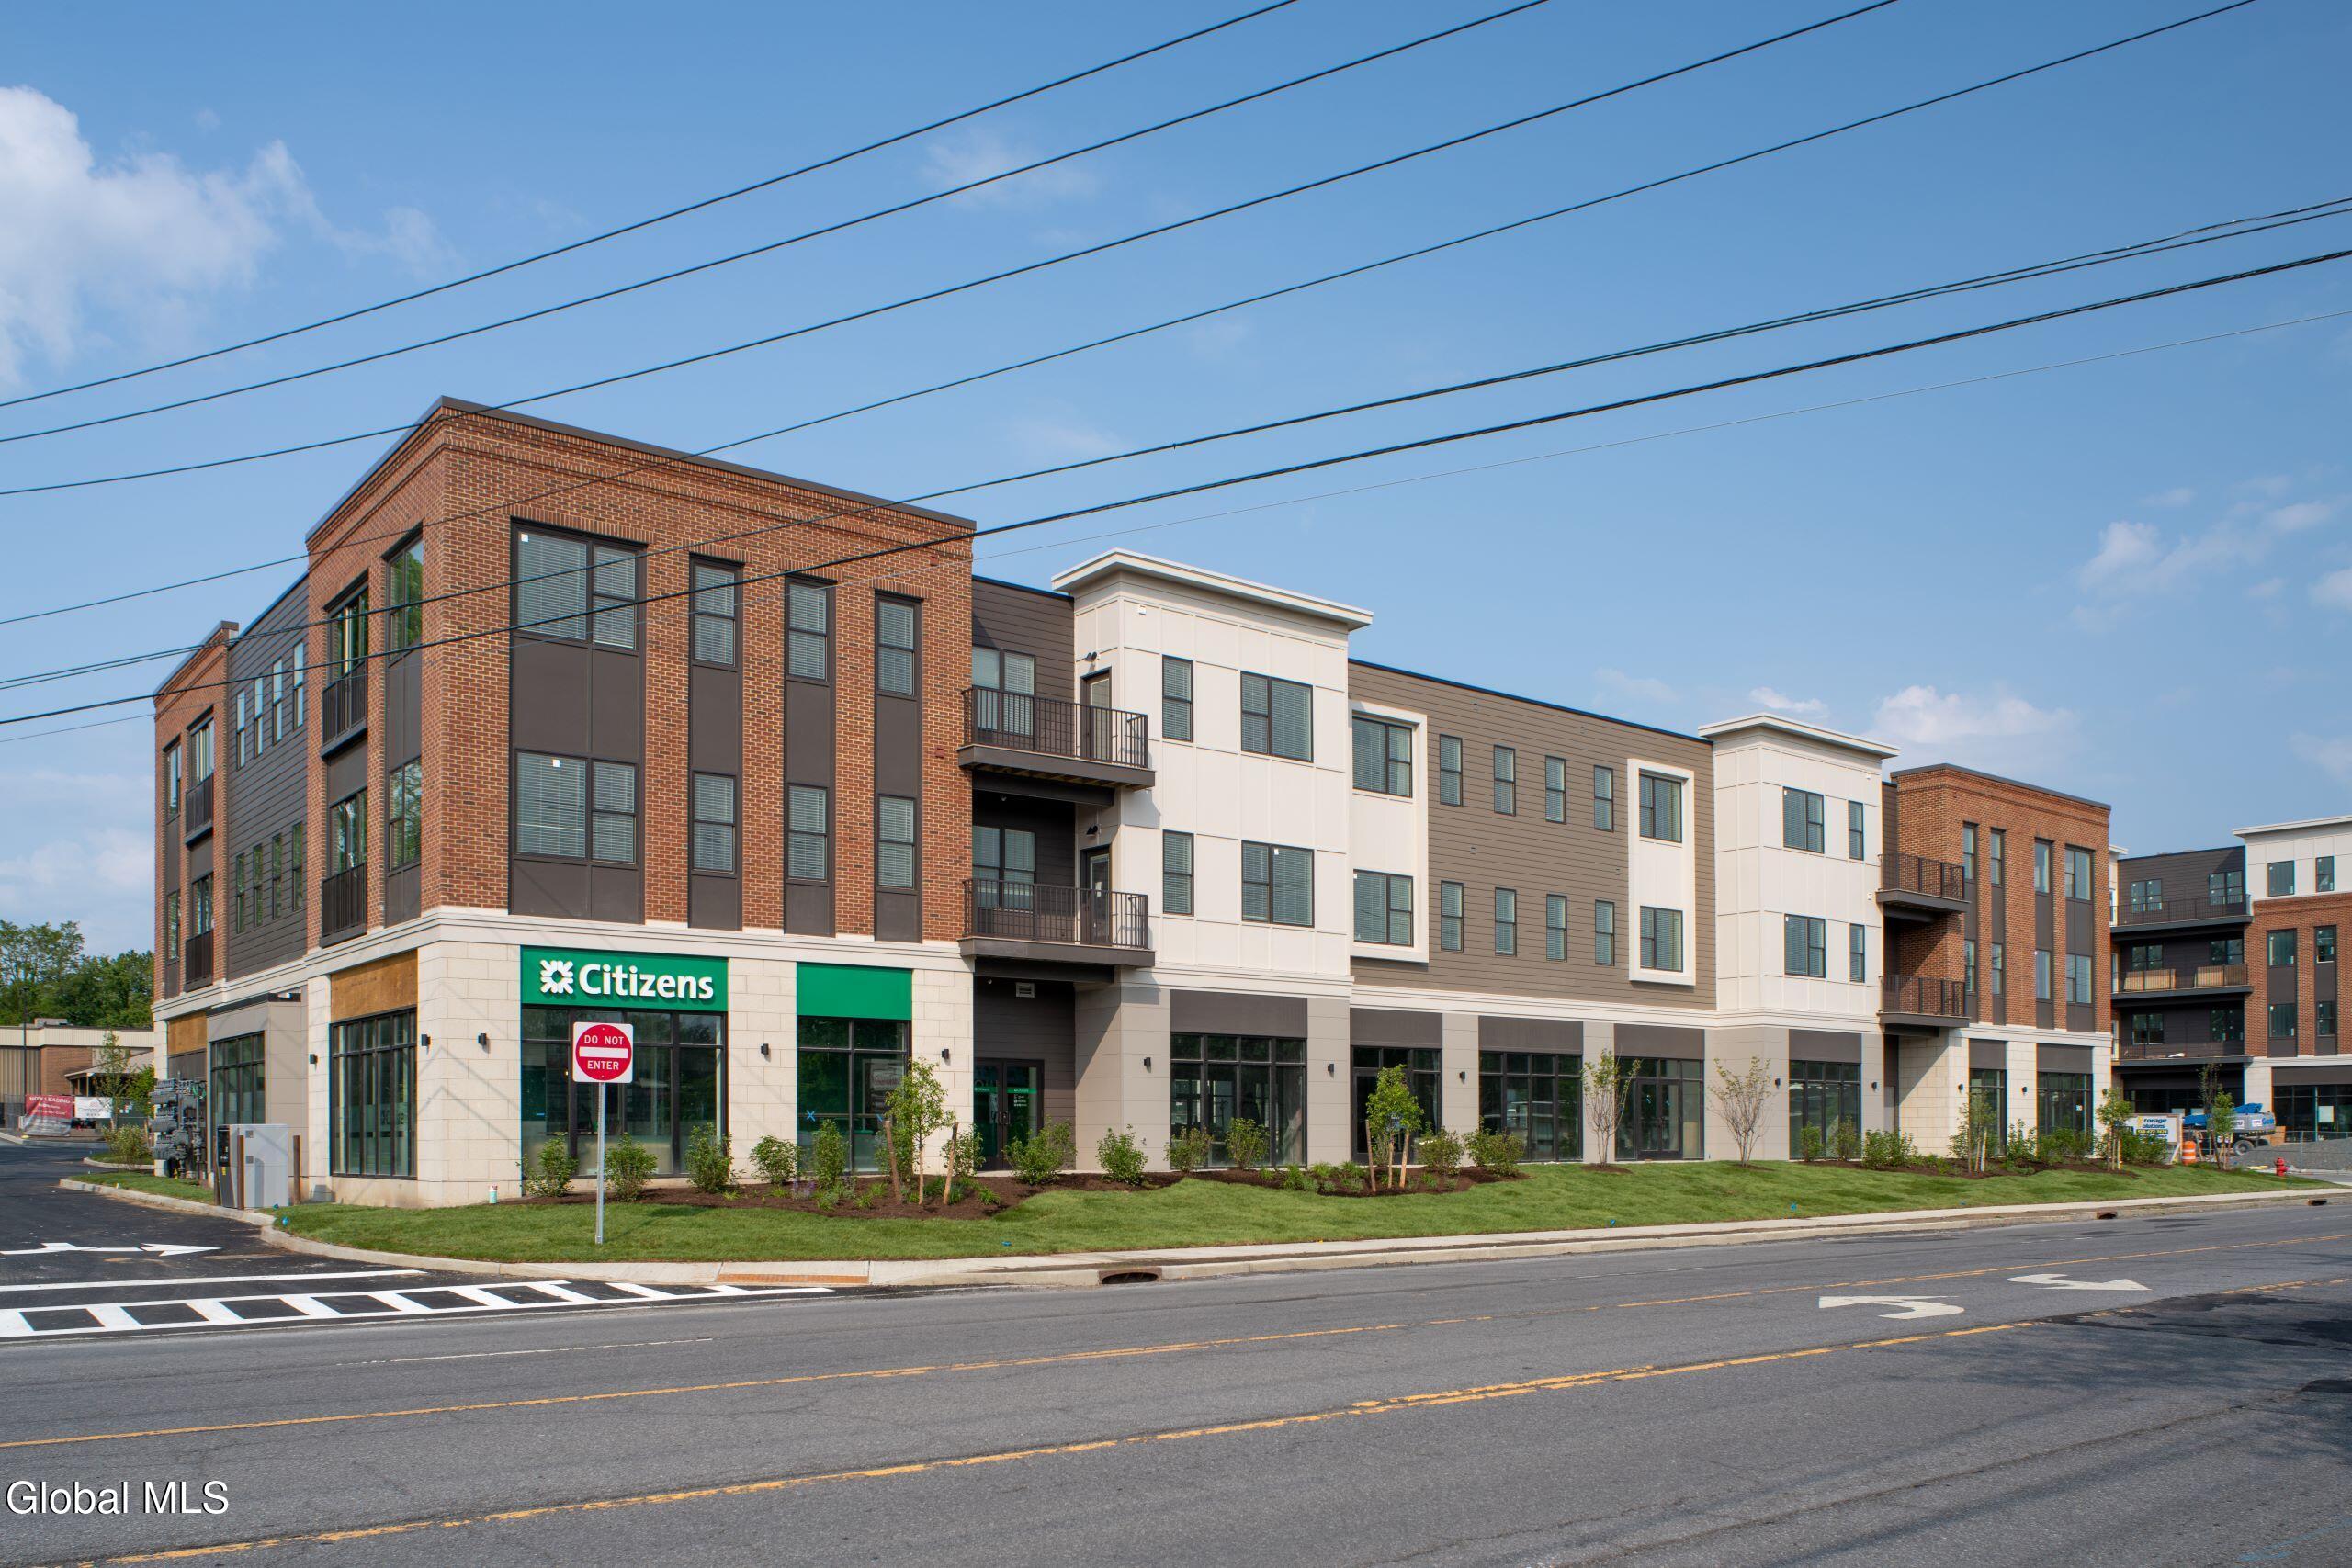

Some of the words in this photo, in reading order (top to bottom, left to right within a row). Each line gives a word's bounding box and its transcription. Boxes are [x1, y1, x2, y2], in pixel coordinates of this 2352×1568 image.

[579, 963, 714, 999] Citizens
[583, 1034, 598, 1044] DO
[605, 1035, 625, 1045] NOT
[587, 1060, 619, 1070] ENTER
